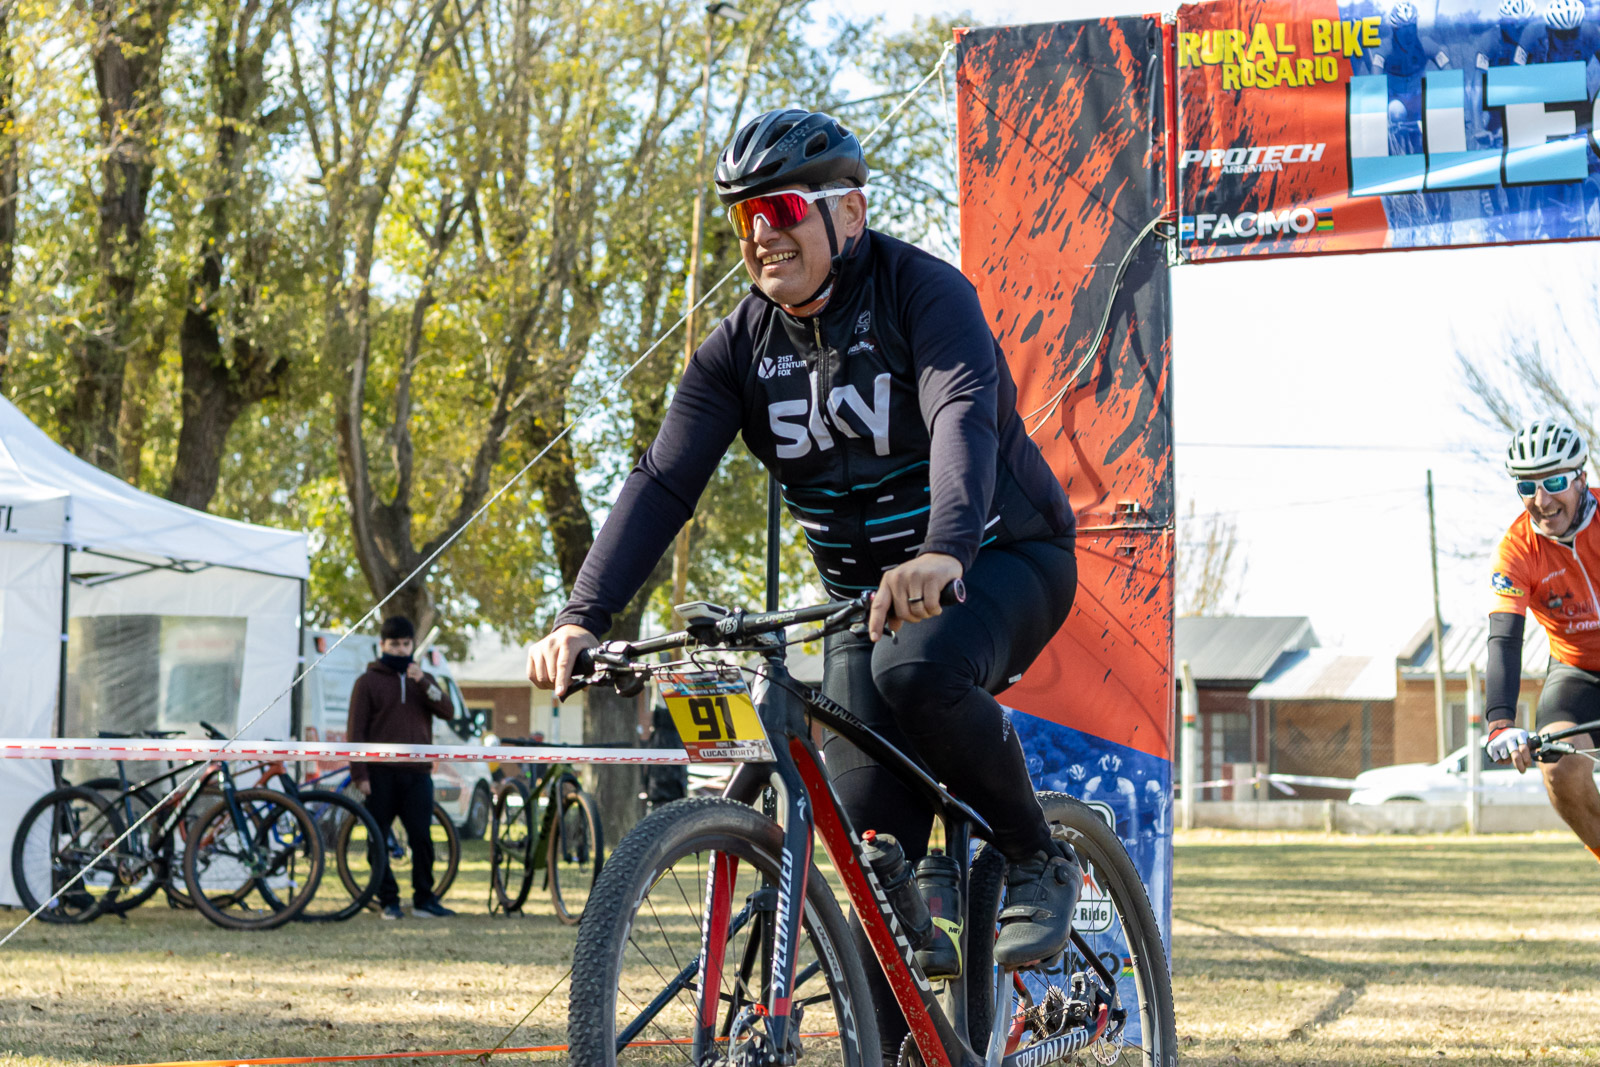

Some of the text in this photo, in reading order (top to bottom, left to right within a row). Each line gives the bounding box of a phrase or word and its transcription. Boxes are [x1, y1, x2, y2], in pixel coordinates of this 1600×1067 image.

[1179, 16, 1382, 69] RURAL BIKE
[1222, 55, 1339, 91] ROSARIO
[1347, 60, 1600, 198] LLE
[1179, 143, 1327, 169] PROTECH
[1220, 161, 1284, 174] ARGENTINA
[1195, 207, 1317, 241] FACIMO
[777, 354, 794, 364] 21ST
[777, 359, 807, 370] CENTUR
[777, 369, 792, 377] FOX
[755, 611, 797, 624] CARBON
[688, 696, 737, 740] 91
[702, 750, 728, 758] LUCAS
[770, 847, 793, 998] SPECIALIZED
[1080, 907, 1108, 921] Ride
[816, 925, 841, 977] DEORE
